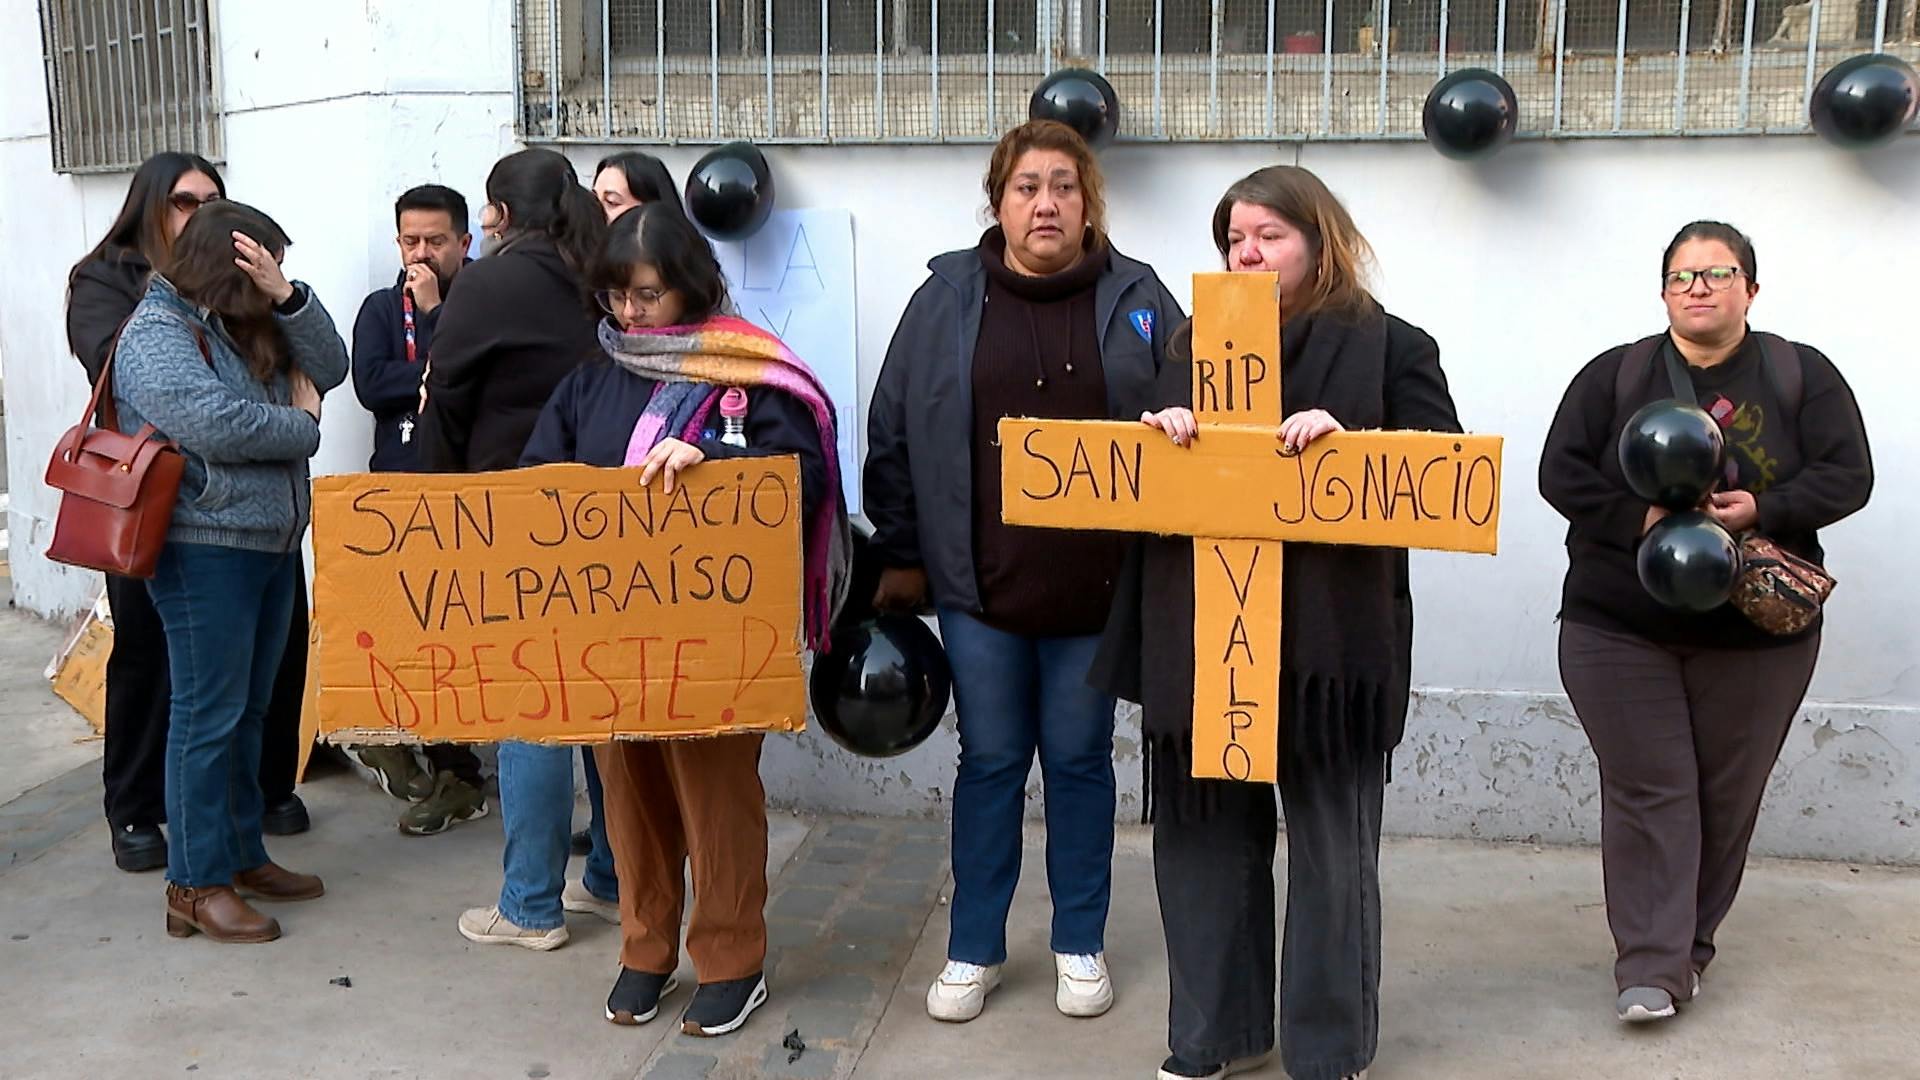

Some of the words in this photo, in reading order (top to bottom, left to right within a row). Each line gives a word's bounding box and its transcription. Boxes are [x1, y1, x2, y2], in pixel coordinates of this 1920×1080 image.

[1021, 428, 1143, 503] SAN
[343, 488, 495, 556] SAN
[398, 544, 754, 631] VALPARAÍSO
[1213, 544, 1260, 782] VALPO
